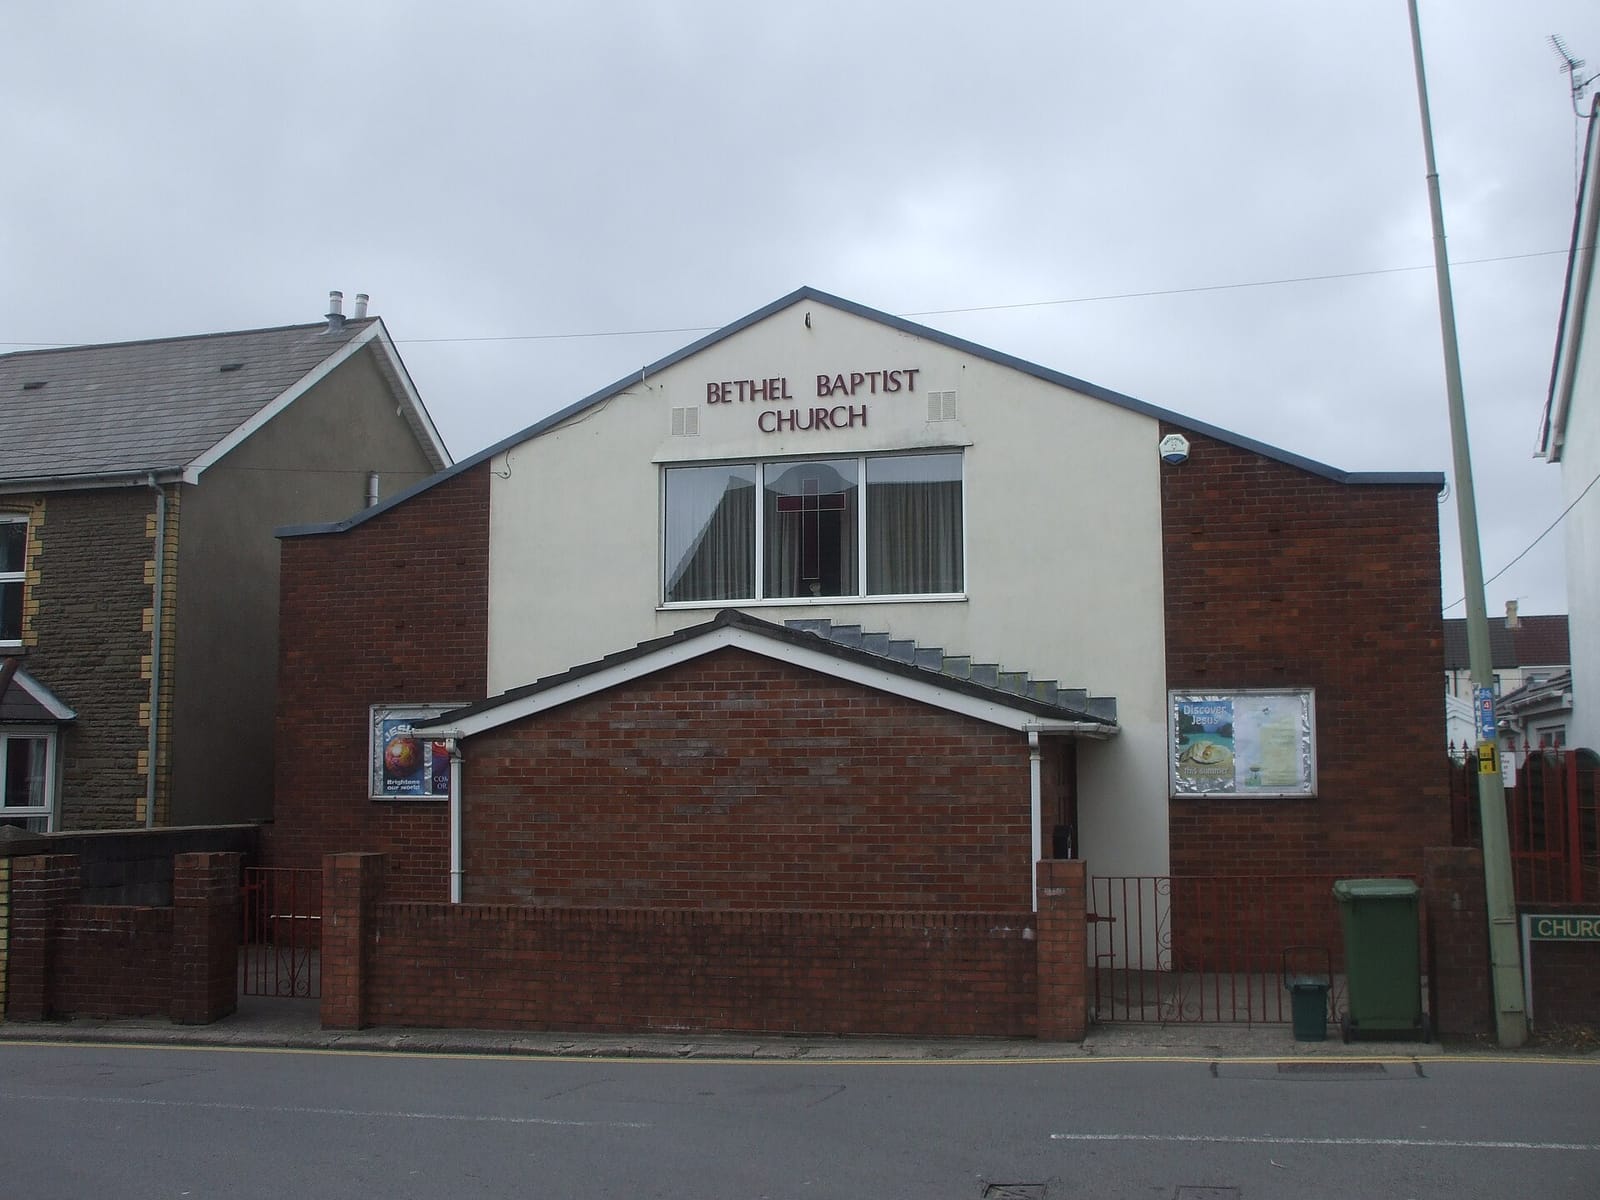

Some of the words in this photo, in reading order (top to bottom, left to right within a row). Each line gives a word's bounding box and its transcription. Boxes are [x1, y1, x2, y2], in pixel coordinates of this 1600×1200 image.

[706, 377, 793, 404] BETHEL
[816, 368, 920, 397] BAPTIST
[757, 404, 868, 433] CHURCH
[1183, 704, 1227, 716] Discover
[1191, 715, 1219, 726] Jesus
